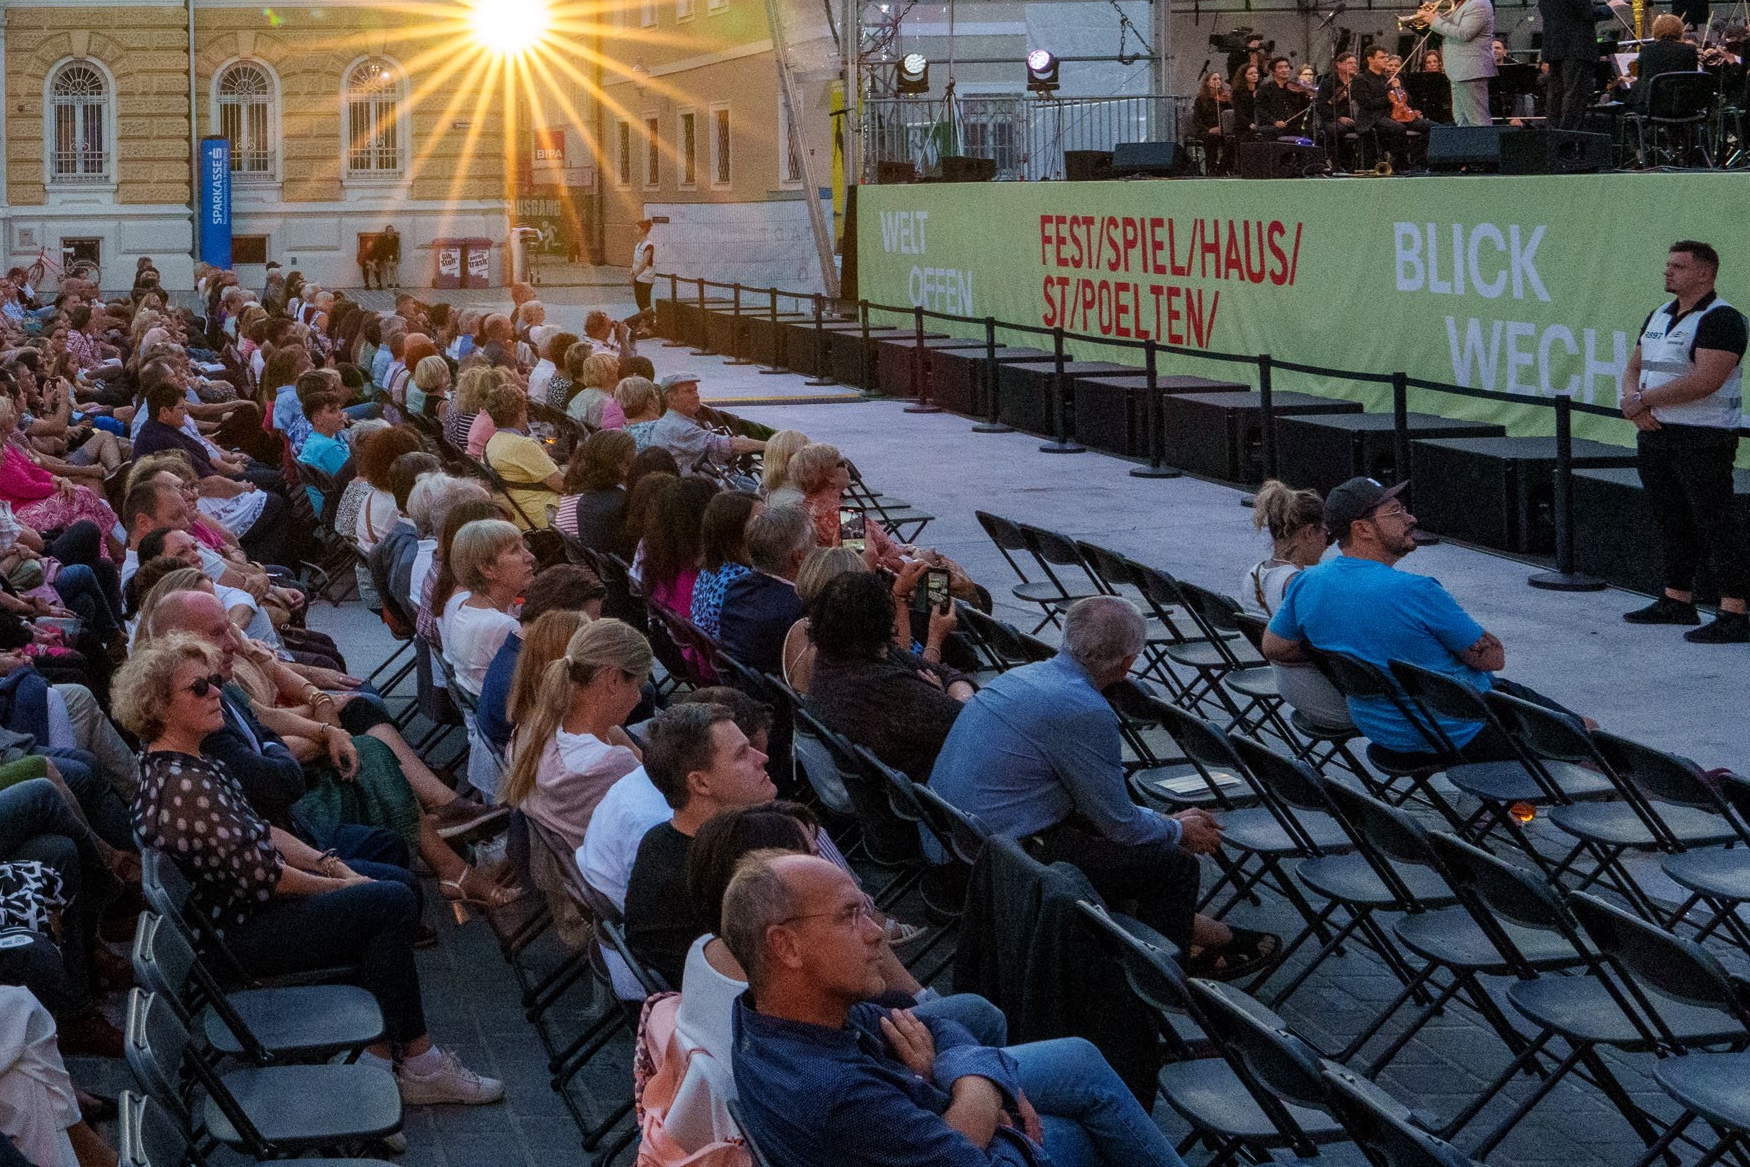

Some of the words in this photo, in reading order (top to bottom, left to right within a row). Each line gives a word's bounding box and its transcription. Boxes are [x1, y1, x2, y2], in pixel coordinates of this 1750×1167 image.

[537, 149, 563, 159] BIPA
[212, 160, 223, 225] SPARKASSE
[509, 199, 561, 217] AUSGANG
[880, 211, 929, 255] WELT
[1040, 214, 1303, 286] FEST/SPIEL/HAUS/
[1393, 221, 1550, 302] BLICK
[908, 266, 974, 316] OFFEN
[1043, 275, 1219, 349] ST/POELTEN/
